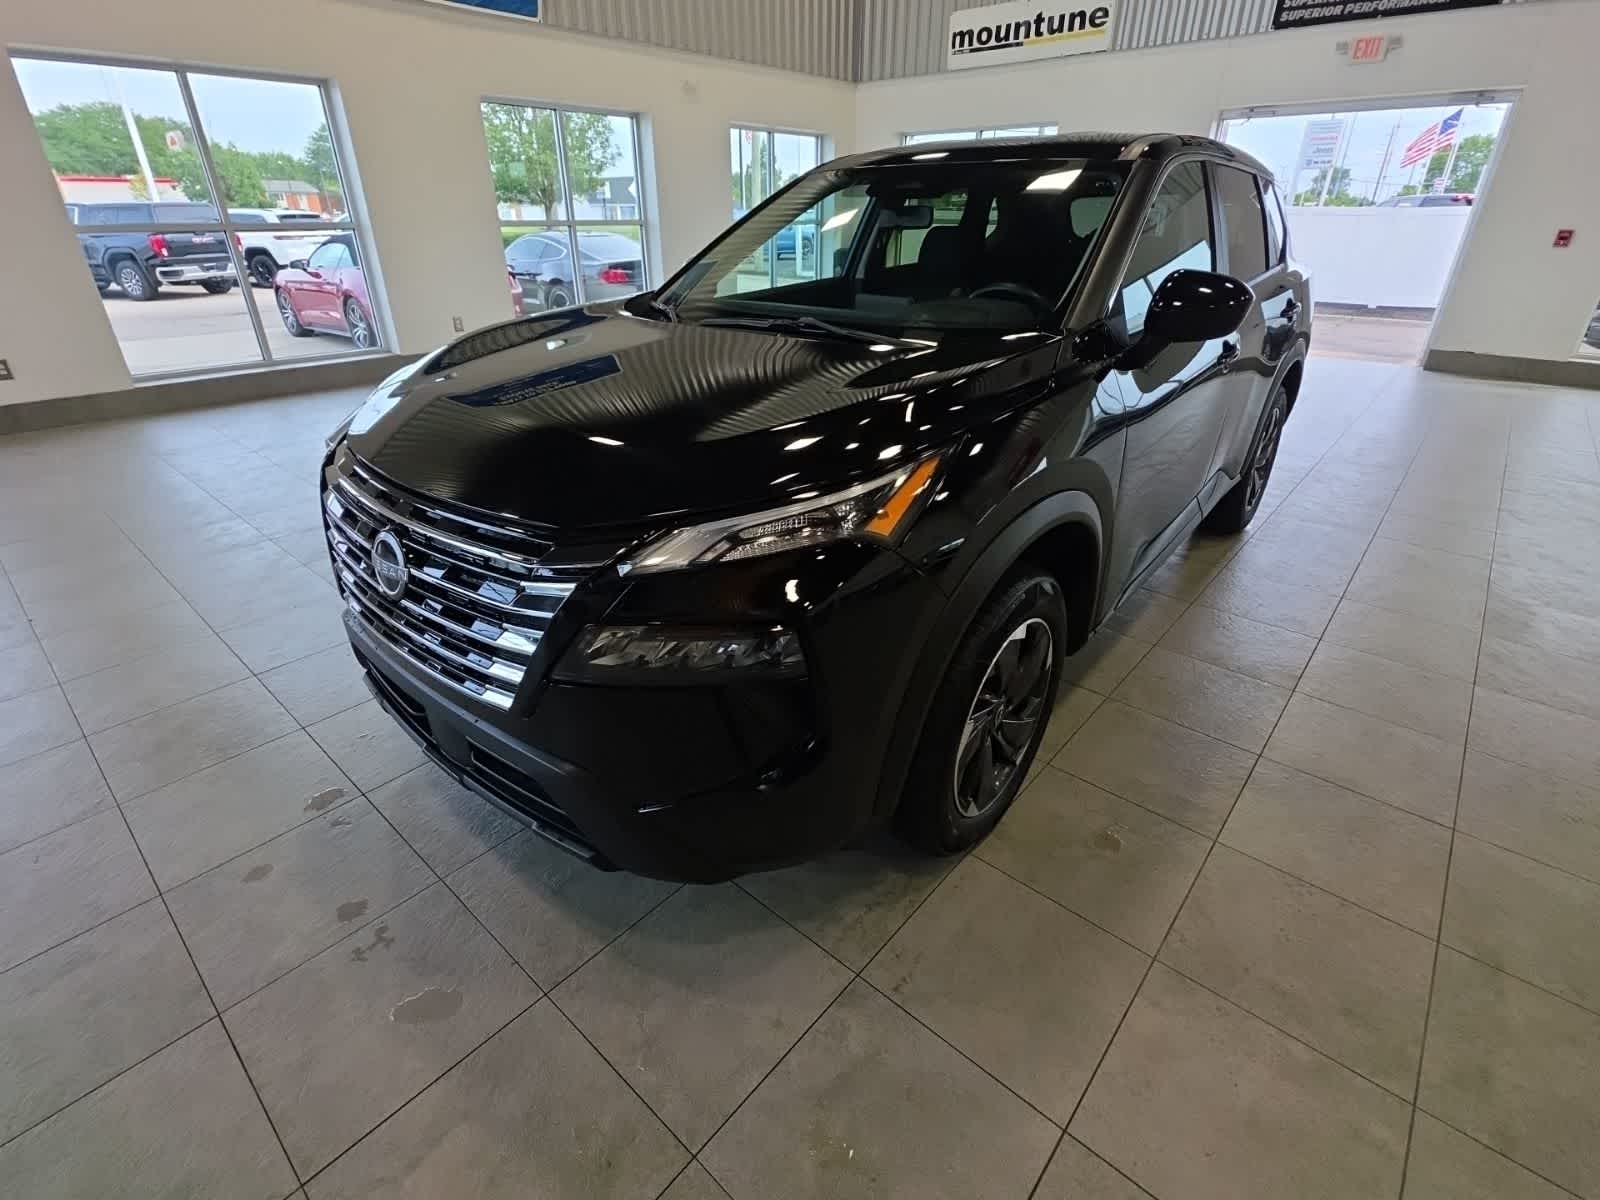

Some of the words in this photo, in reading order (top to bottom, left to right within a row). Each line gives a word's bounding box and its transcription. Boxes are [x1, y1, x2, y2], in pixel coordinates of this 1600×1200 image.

[1280, 5, 1344, 21] SUPERIOR
[1344, 0, 1450, 15] PERFORMAN.
[951, 6, 1110, 49] mountune
[1352, 37, 1384, 60] EXIT
